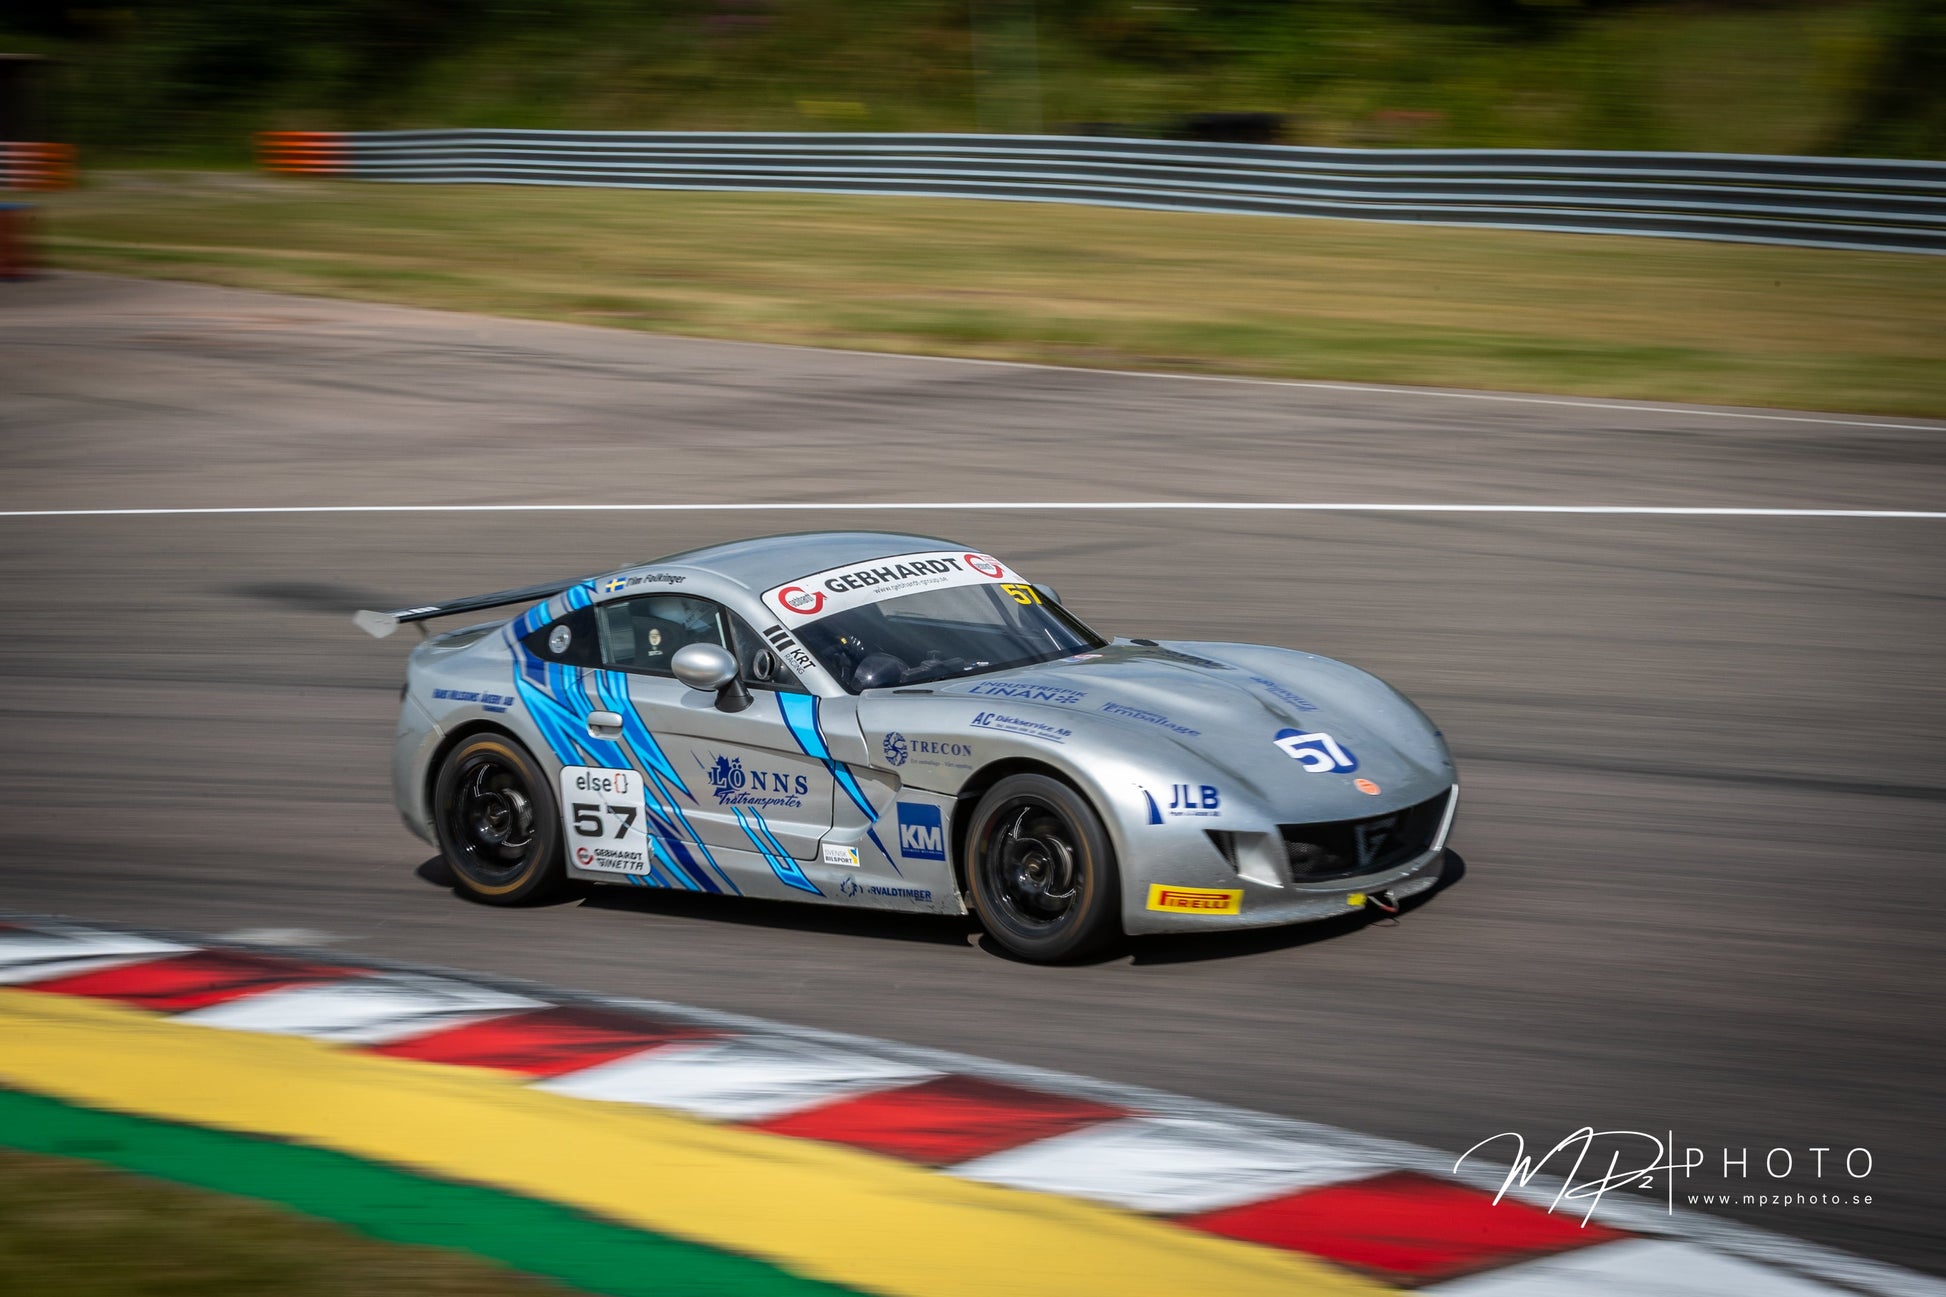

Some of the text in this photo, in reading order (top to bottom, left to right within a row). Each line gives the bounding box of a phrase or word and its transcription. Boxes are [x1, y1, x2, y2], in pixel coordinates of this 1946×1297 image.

[824, 558, 964, 593] GEBHARDT
[1000, 584, 1043, 605] 57
[784, 653, 805, 675] RACING
[790, 648, 816, 669] KRT
[968, 686, 1057, 701] LINAN
[971, 712, 995, 726] AC
[1055, 728, 1072, 736] AB
[909, 740, 972, 756] TRECON
[1273, 732, 1354, 773] 57
[711, 763, 808, 795] LÖNNS
[1169, 784, 1219, 810] JLB
[572, 802, 637, 840] 57
[900, 824, 943, 852] KM
[593, 848, 643, 861] GEBHARDT
[825, 855, 852, 864] BILSPORT
[1158, 890, 1232, 909] PIRELLI
